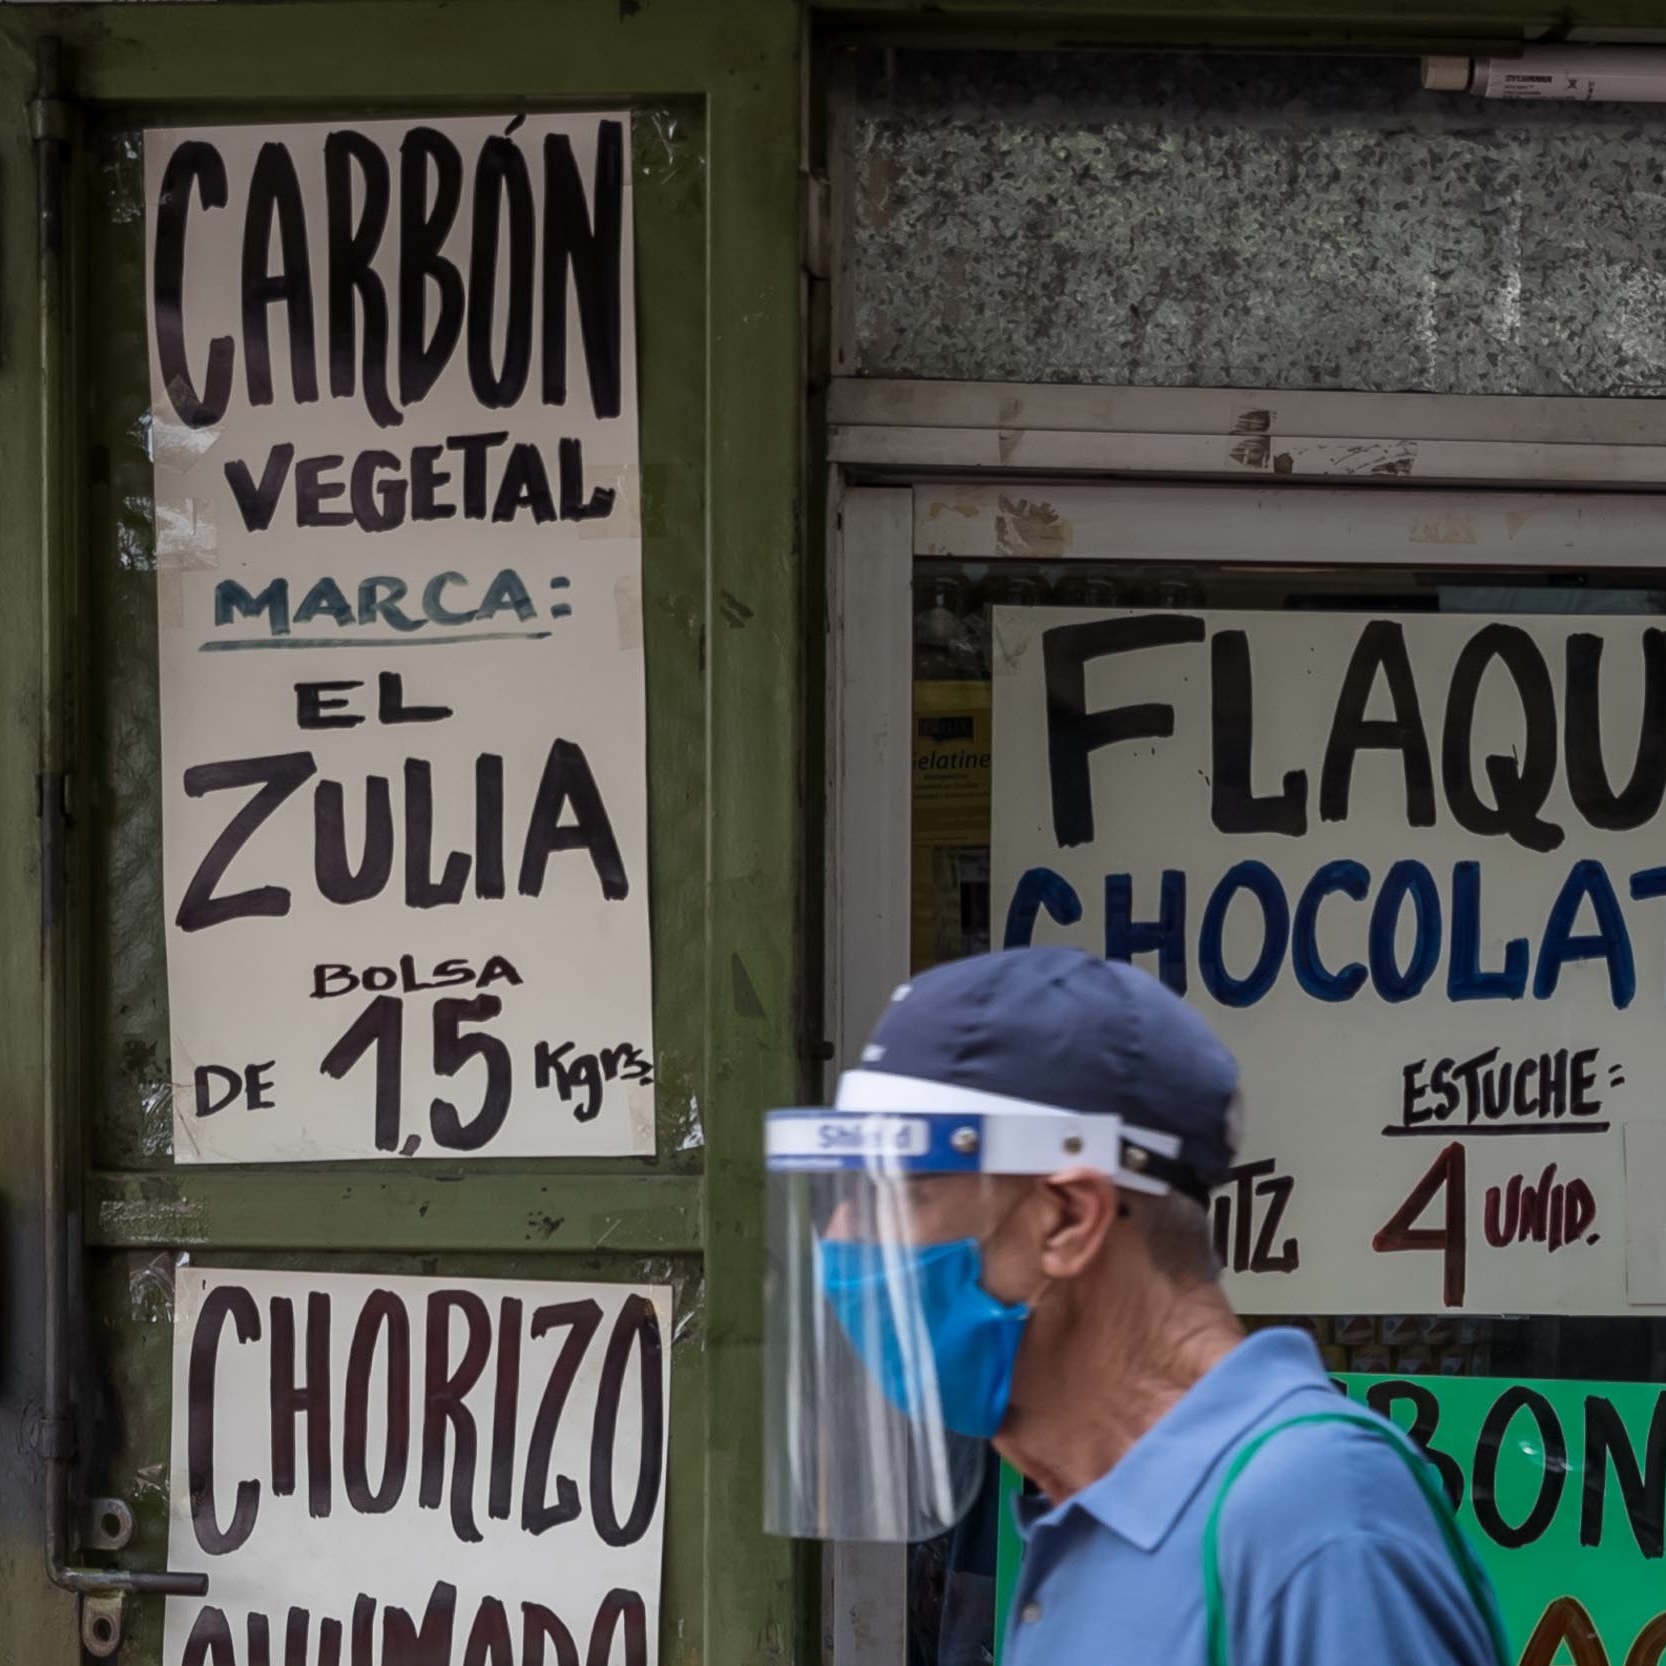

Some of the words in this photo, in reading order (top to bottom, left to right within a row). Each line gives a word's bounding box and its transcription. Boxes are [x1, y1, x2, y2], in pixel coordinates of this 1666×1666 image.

[154, 112, 625, 429] CARBÓN
[224, 430, 616, 533] VEGETAL
[214, 568, 572, 636] MARCA:
[293, 671, 454, 730] EL
[913, 748, 992, 772] elatine
[174, 737, 629, 933] ZULIA
[309, 954, 524, 999] BOLSA
[193, 1060, 276, 1118] DE
[1403, 1046, 1625, 1126] ESTUCHE:
[1372, 1141, 1467, 1308] 4
[1484, 1162, 1600, 1253] UNID.
[187, 1285, 664, 1556] CHORIZO
